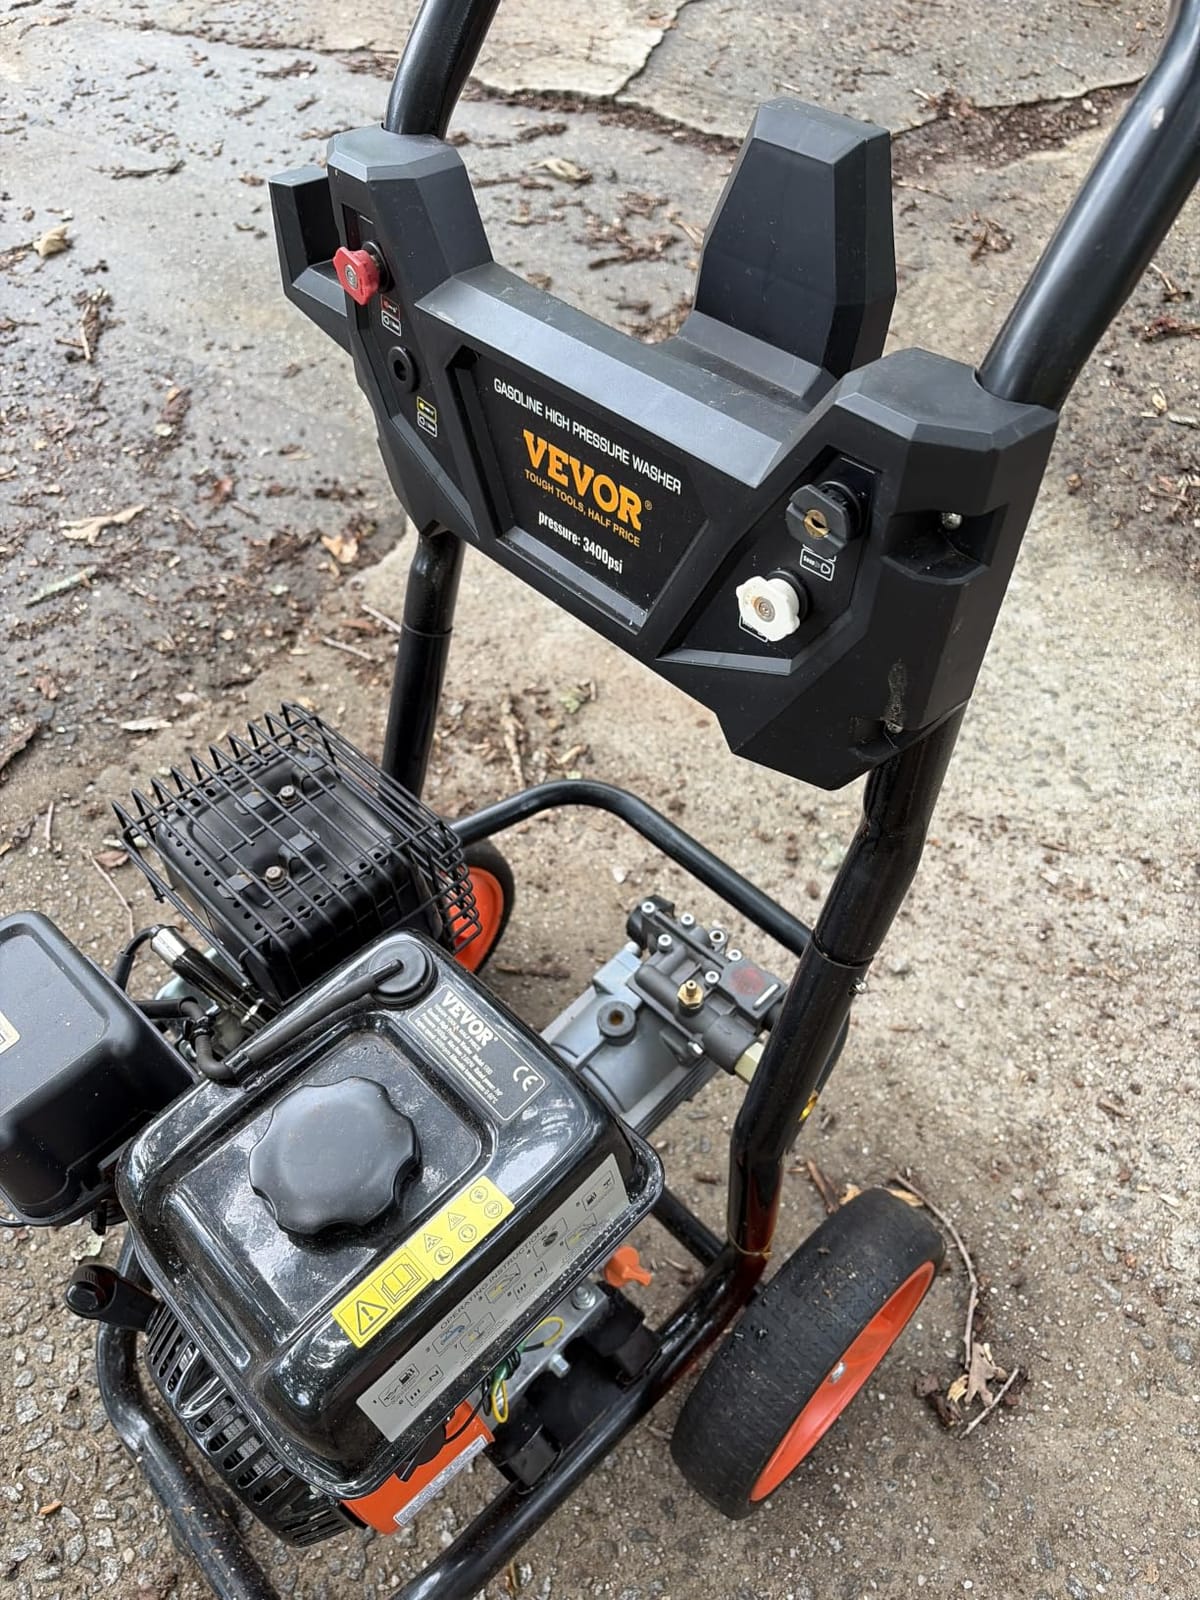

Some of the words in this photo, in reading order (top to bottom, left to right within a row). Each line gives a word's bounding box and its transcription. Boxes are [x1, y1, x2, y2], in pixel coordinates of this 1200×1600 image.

[494, 378, 543, 417] GASOLINE
[545, 406, 570, 430] HIGH
[572, 422, 629, 466] PRESSURE
[632, 454, 681, 495] WASHER
[524, 469, 554, 493] TOUGH
[556, 488, 587, 515] TOOLS,
[588, 508, 611, 531] HALF
[612, 525, 641, 548] PRICE
[539, 511, 581, 547] pressure:
[583, 536, 624, 575] 3400psi
[440, 1282, 489, 1329] OPERATING
[489, 1225, 548, 1283] INSTRUCTIONS
